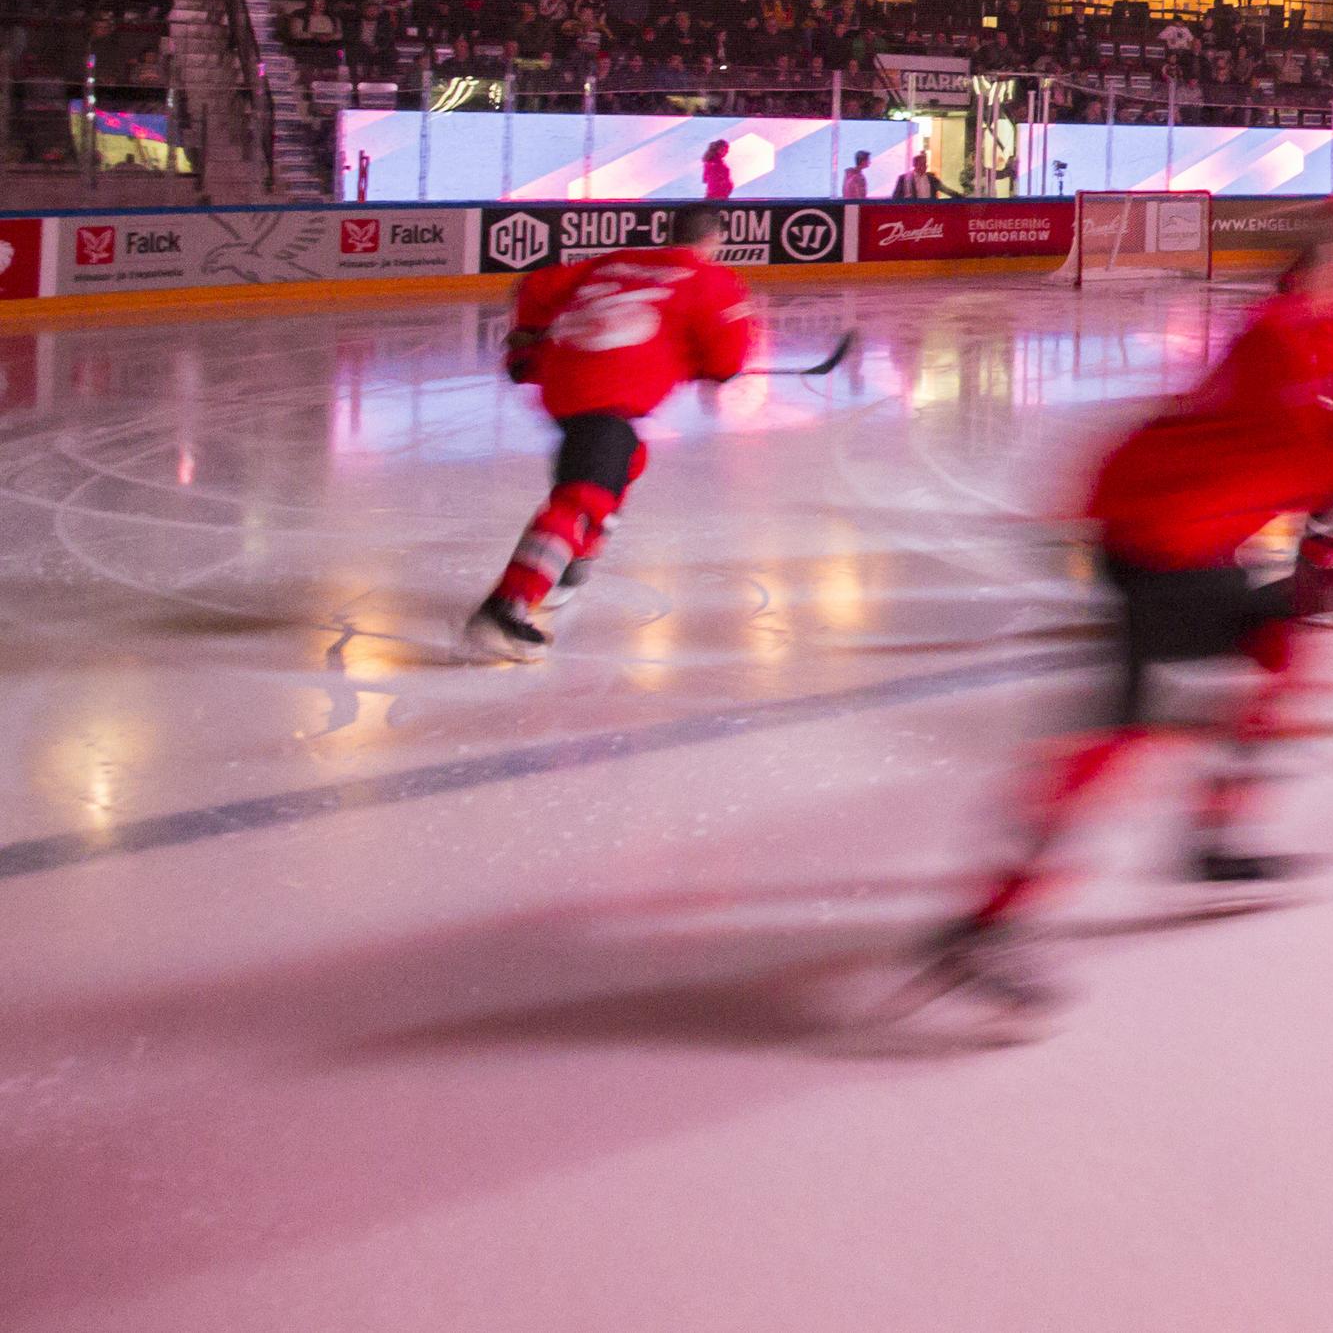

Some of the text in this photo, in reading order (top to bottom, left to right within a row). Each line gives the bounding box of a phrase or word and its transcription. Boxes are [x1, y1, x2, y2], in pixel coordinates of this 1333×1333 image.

[390, 224, 445, 245] Falck
[878, 218, 944, 246] Danfoss
[968, 218, 1051, 230] ENGINEERING
[125, 231, 182, 254] Falck
[968, 230, 1051, 243] TOMORROW
